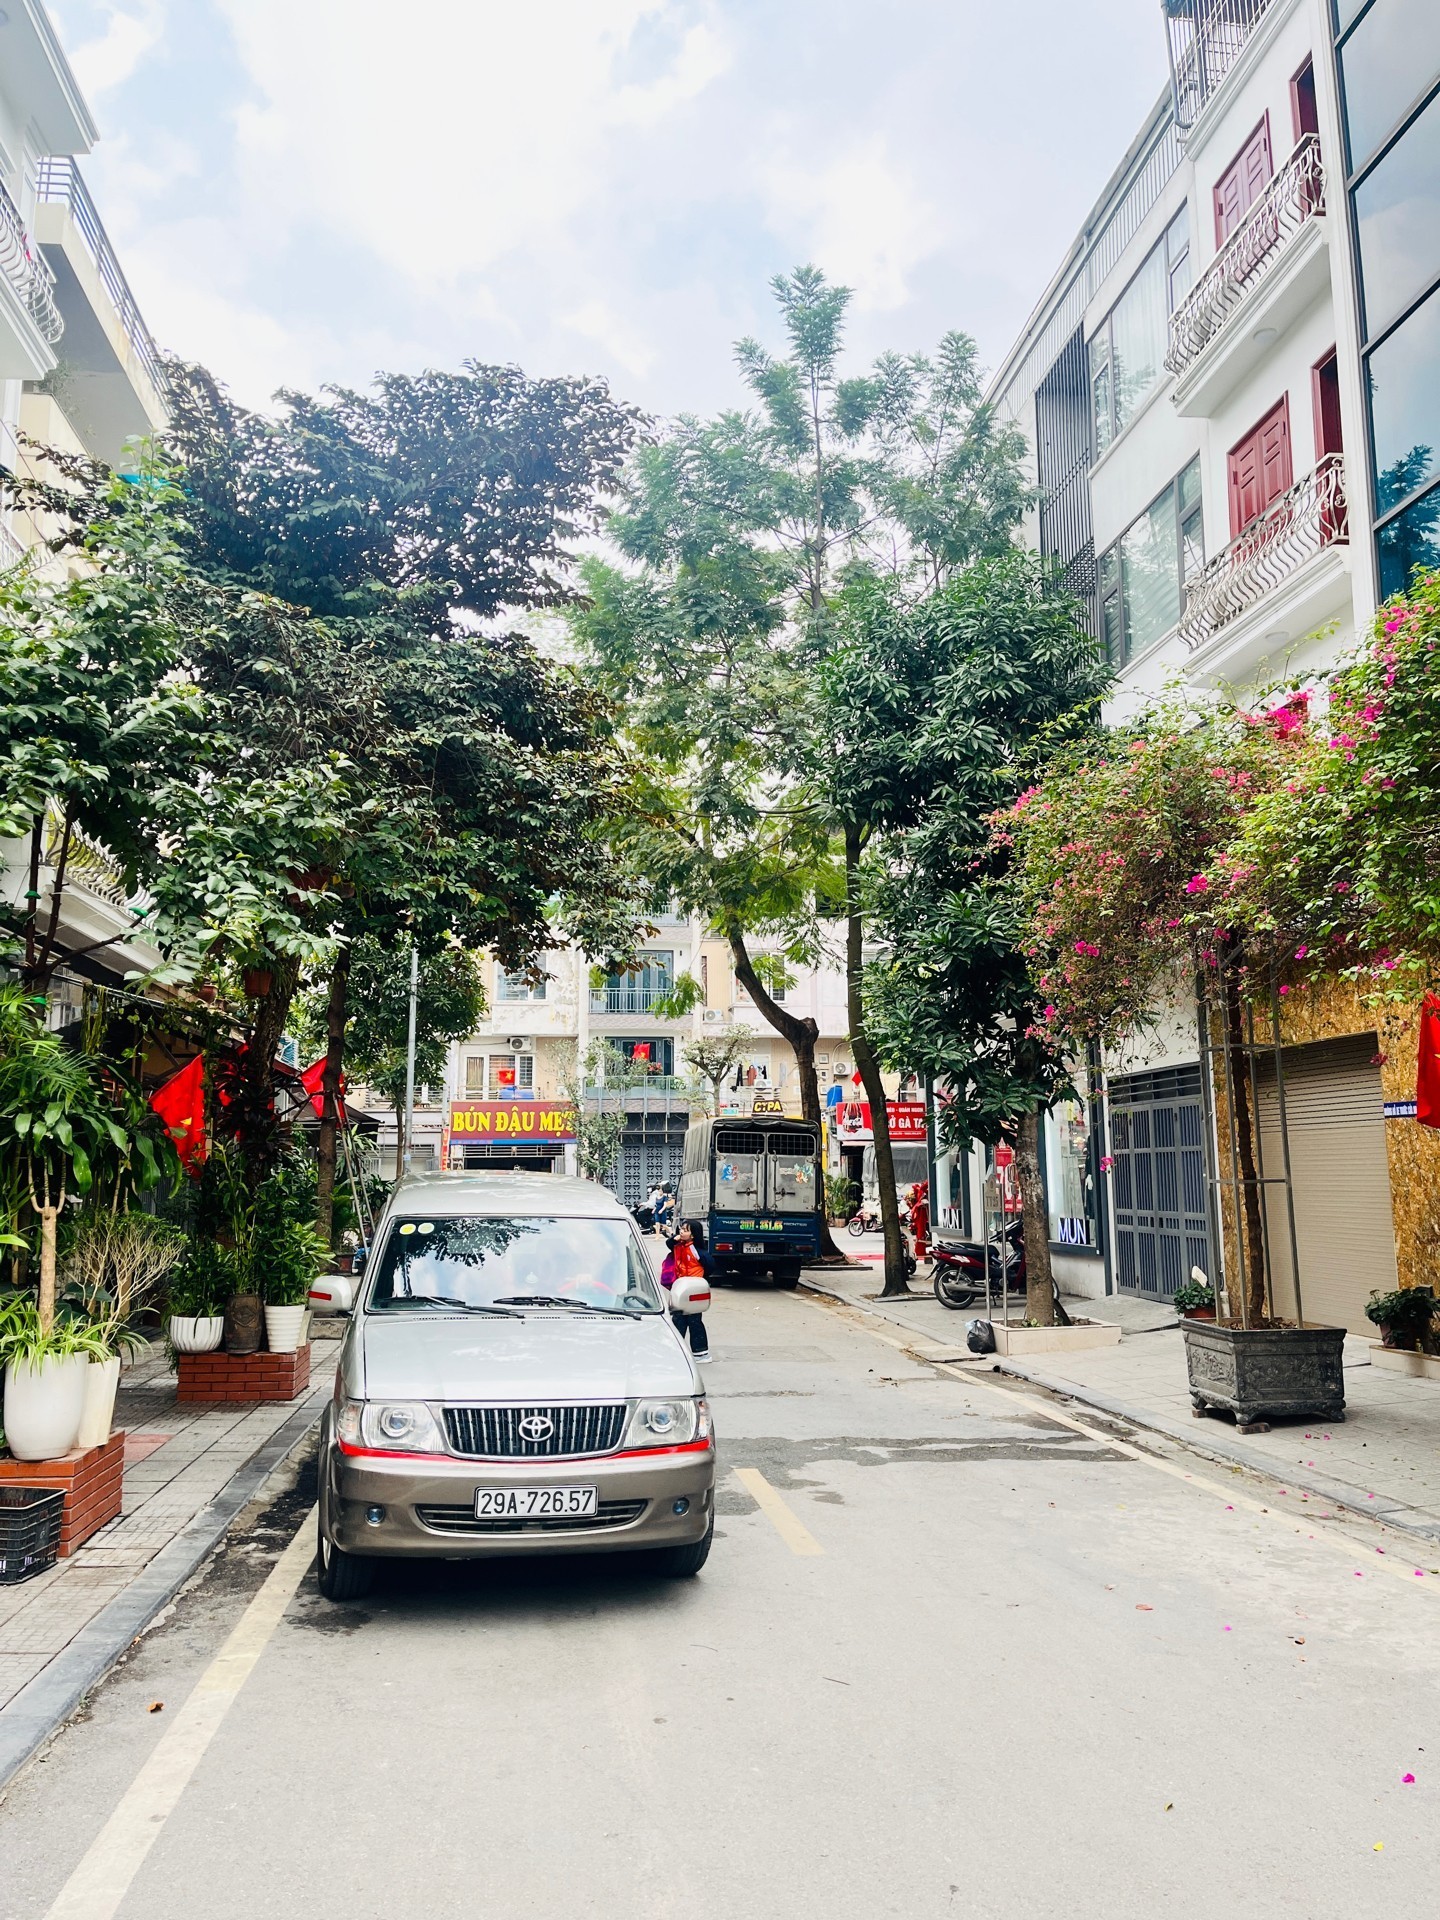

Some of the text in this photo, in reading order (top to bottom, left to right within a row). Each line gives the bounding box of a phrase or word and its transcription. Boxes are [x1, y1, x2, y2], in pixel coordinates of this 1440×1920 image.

[452, 1105, 491, 1132] BÚN
[495, 1105, 535, 1137] ĐẬU
[898, 1115, 912, 1129] GÀ
[942, 1208, 960, 1229] MUN
[1057, 1217, 1087, 1245] MUN
[480, 1489, 594, 1515] 29A-726.57
